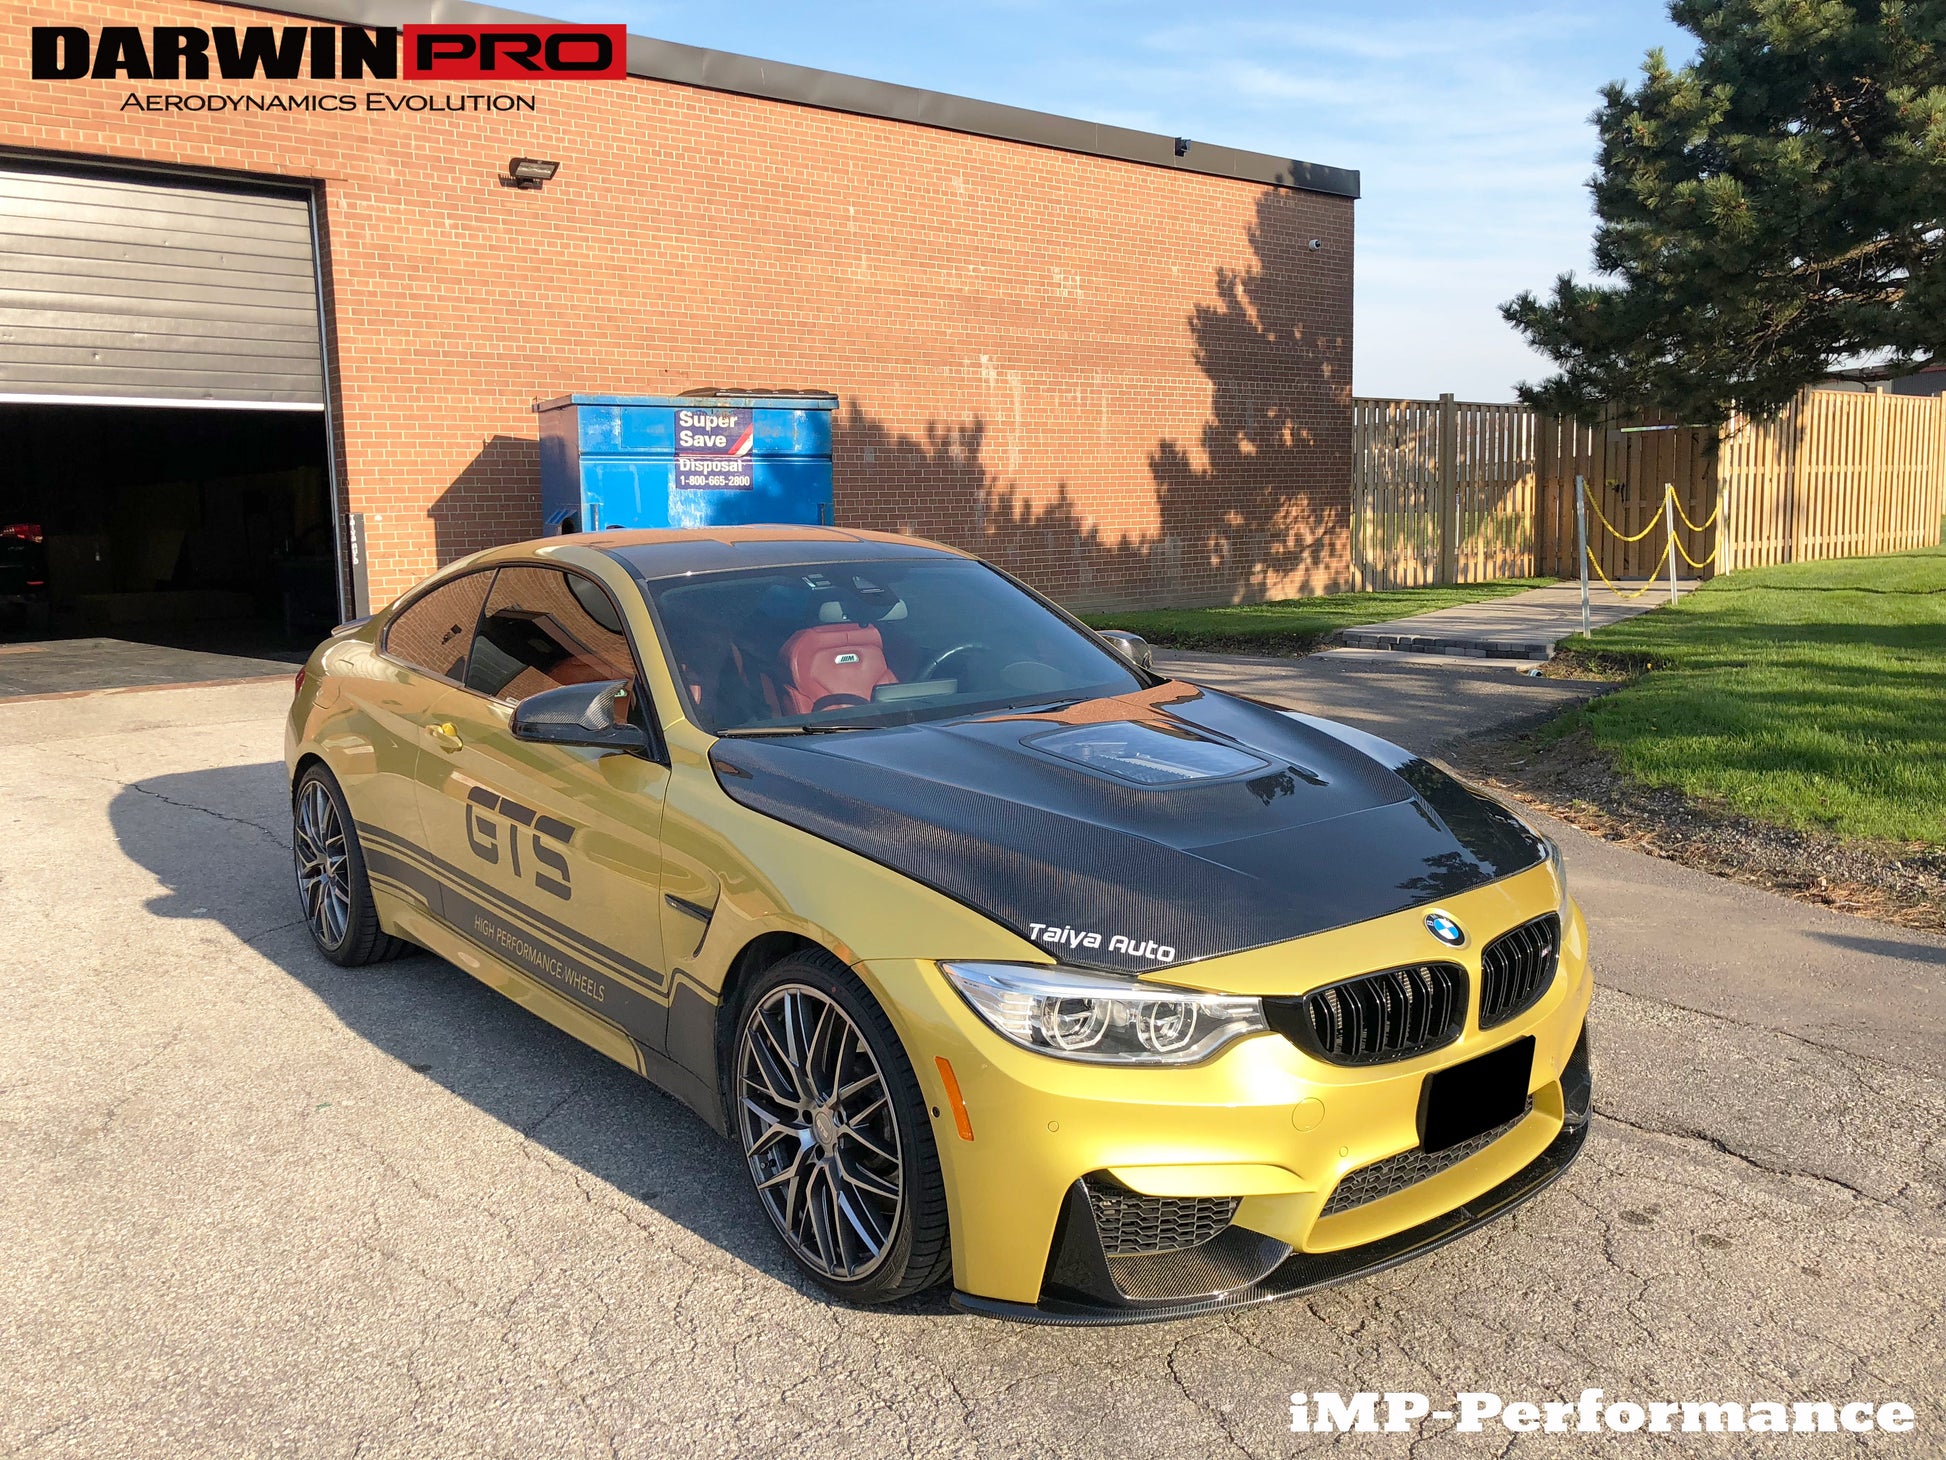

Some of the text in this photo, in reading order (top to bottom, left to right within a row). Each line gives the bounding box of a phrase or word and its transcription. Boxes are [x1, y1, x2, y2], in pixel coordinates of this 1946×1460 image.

[679, 410, 738, 431] Super
[679, 430, 727, 448] Save
[679, 458, 743, 475] Disposal
[680, 475, 750, 487] 1-800-665-2800
[466, 786, 576, 901] GTS
[1029, 923, 1176, 962] Taiya Auto
[474, 914, 606, 1002] HIGH PERFORMANCE WHEELS
